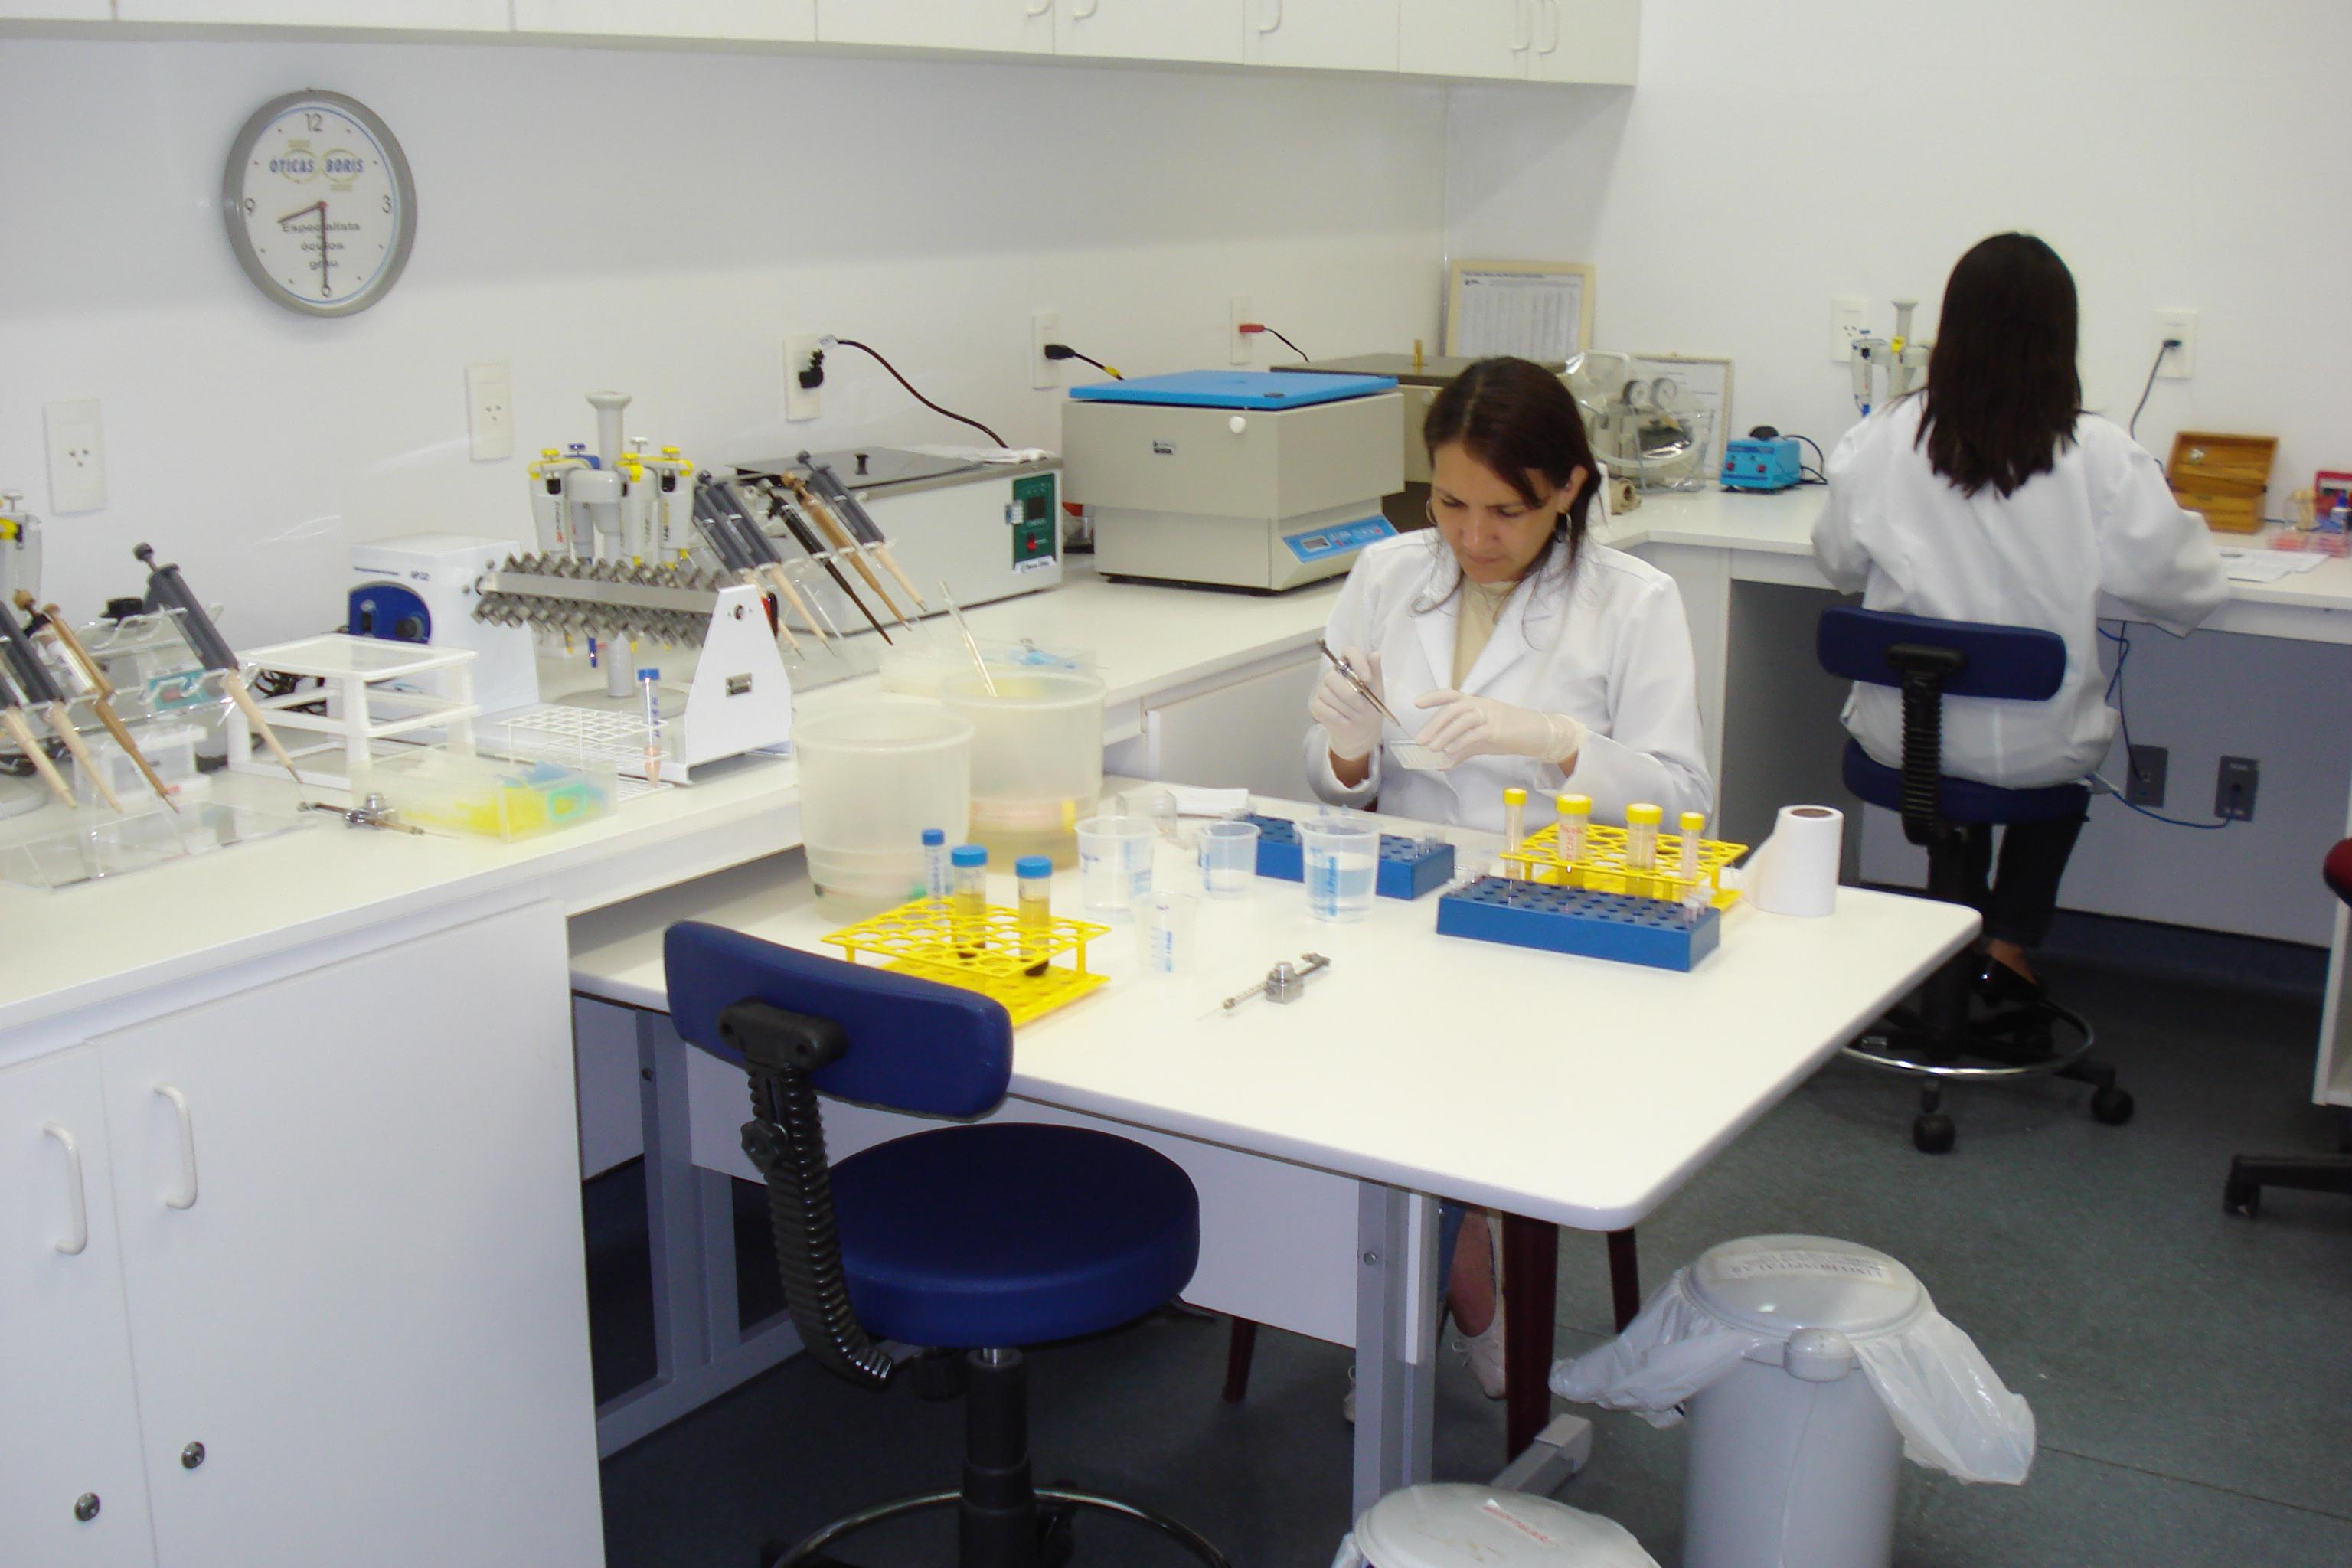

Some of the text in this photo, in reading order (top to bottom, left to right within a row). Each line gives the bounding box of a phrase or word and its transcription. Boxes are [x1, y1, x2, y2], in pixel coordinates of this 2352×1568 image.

[305, 113, 323, 132] 12
[326, 158, 364, 172] BORIS
[244, 198, 256, 214] 9
[383, 195, 391, 214] 3
[282, 221, 360, 233] Especalista
